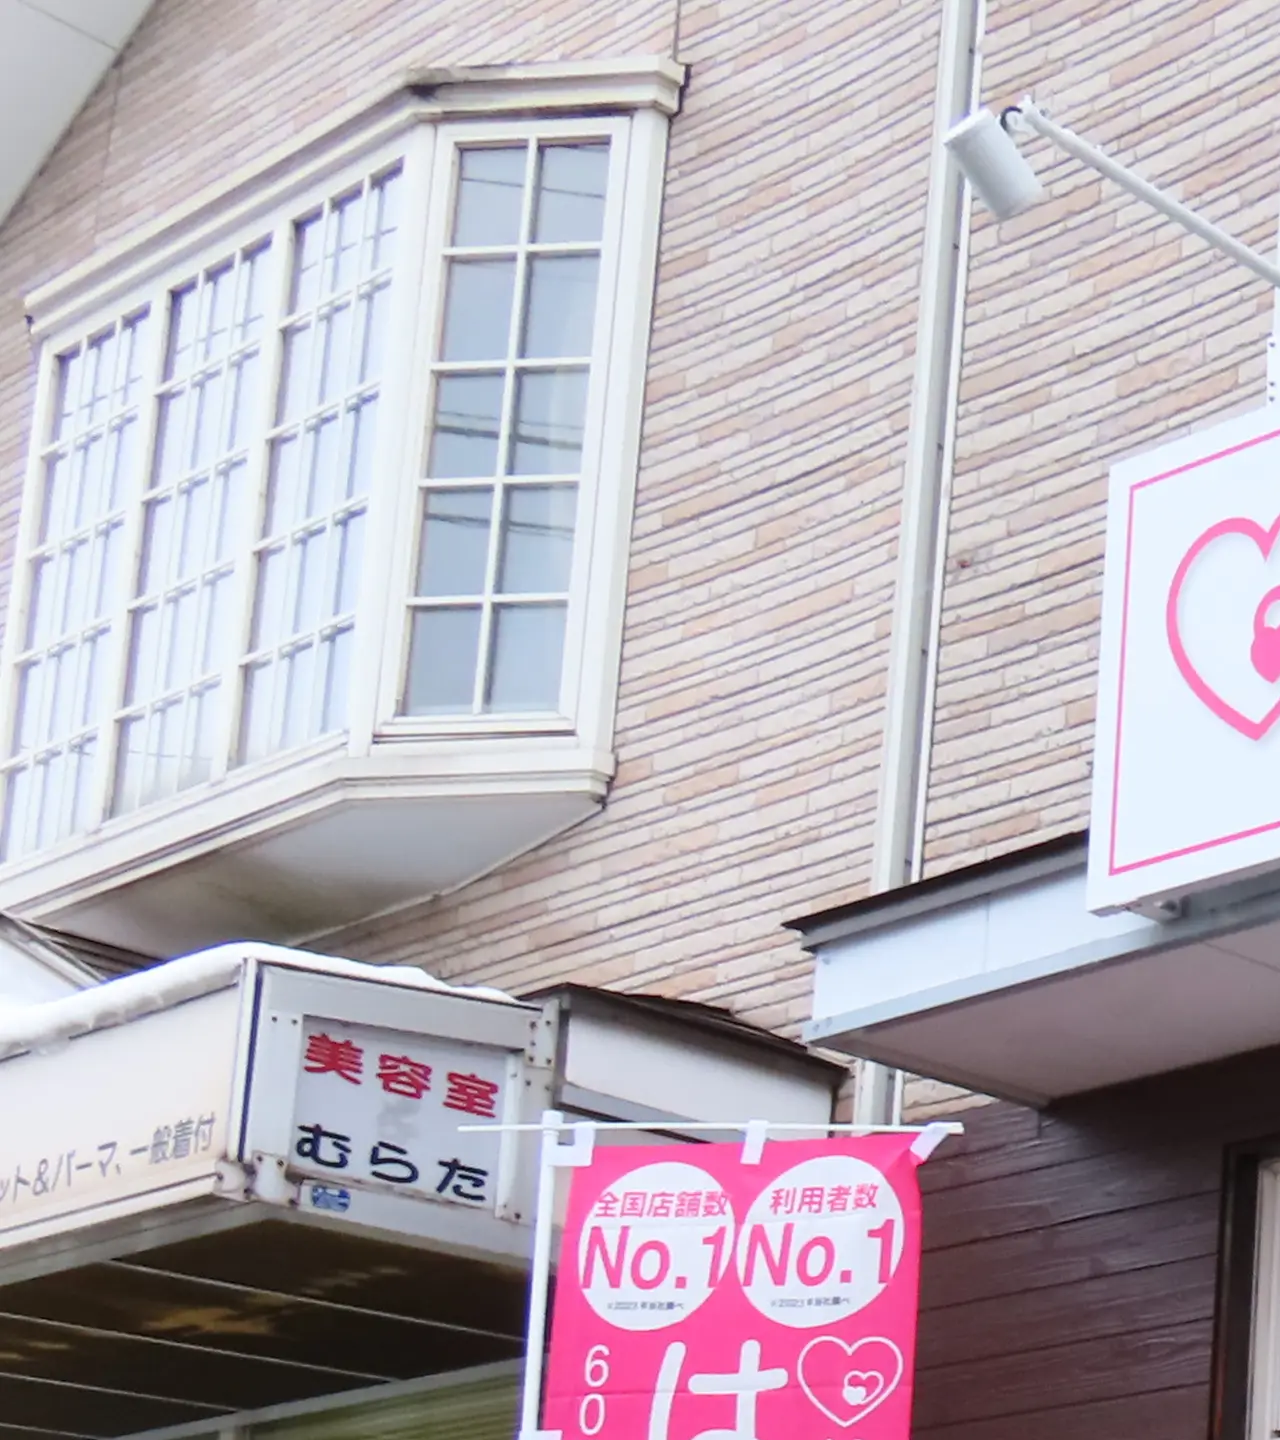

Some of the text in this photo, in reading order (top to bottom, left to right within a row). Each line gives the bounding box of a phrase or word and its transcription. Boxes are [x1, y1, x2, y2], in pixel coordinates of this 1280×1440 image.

[303, 1033, 499, 1119] 美容室
[296, 1123, 488, 1201] むらた
[594, 1190, 731, 1218] 全国店舗数
[769, 1183, 879, 1215] 利用者数
[582, 1225, 727, 1290] No.1
[741, 1219, 895, 1287] No.1
